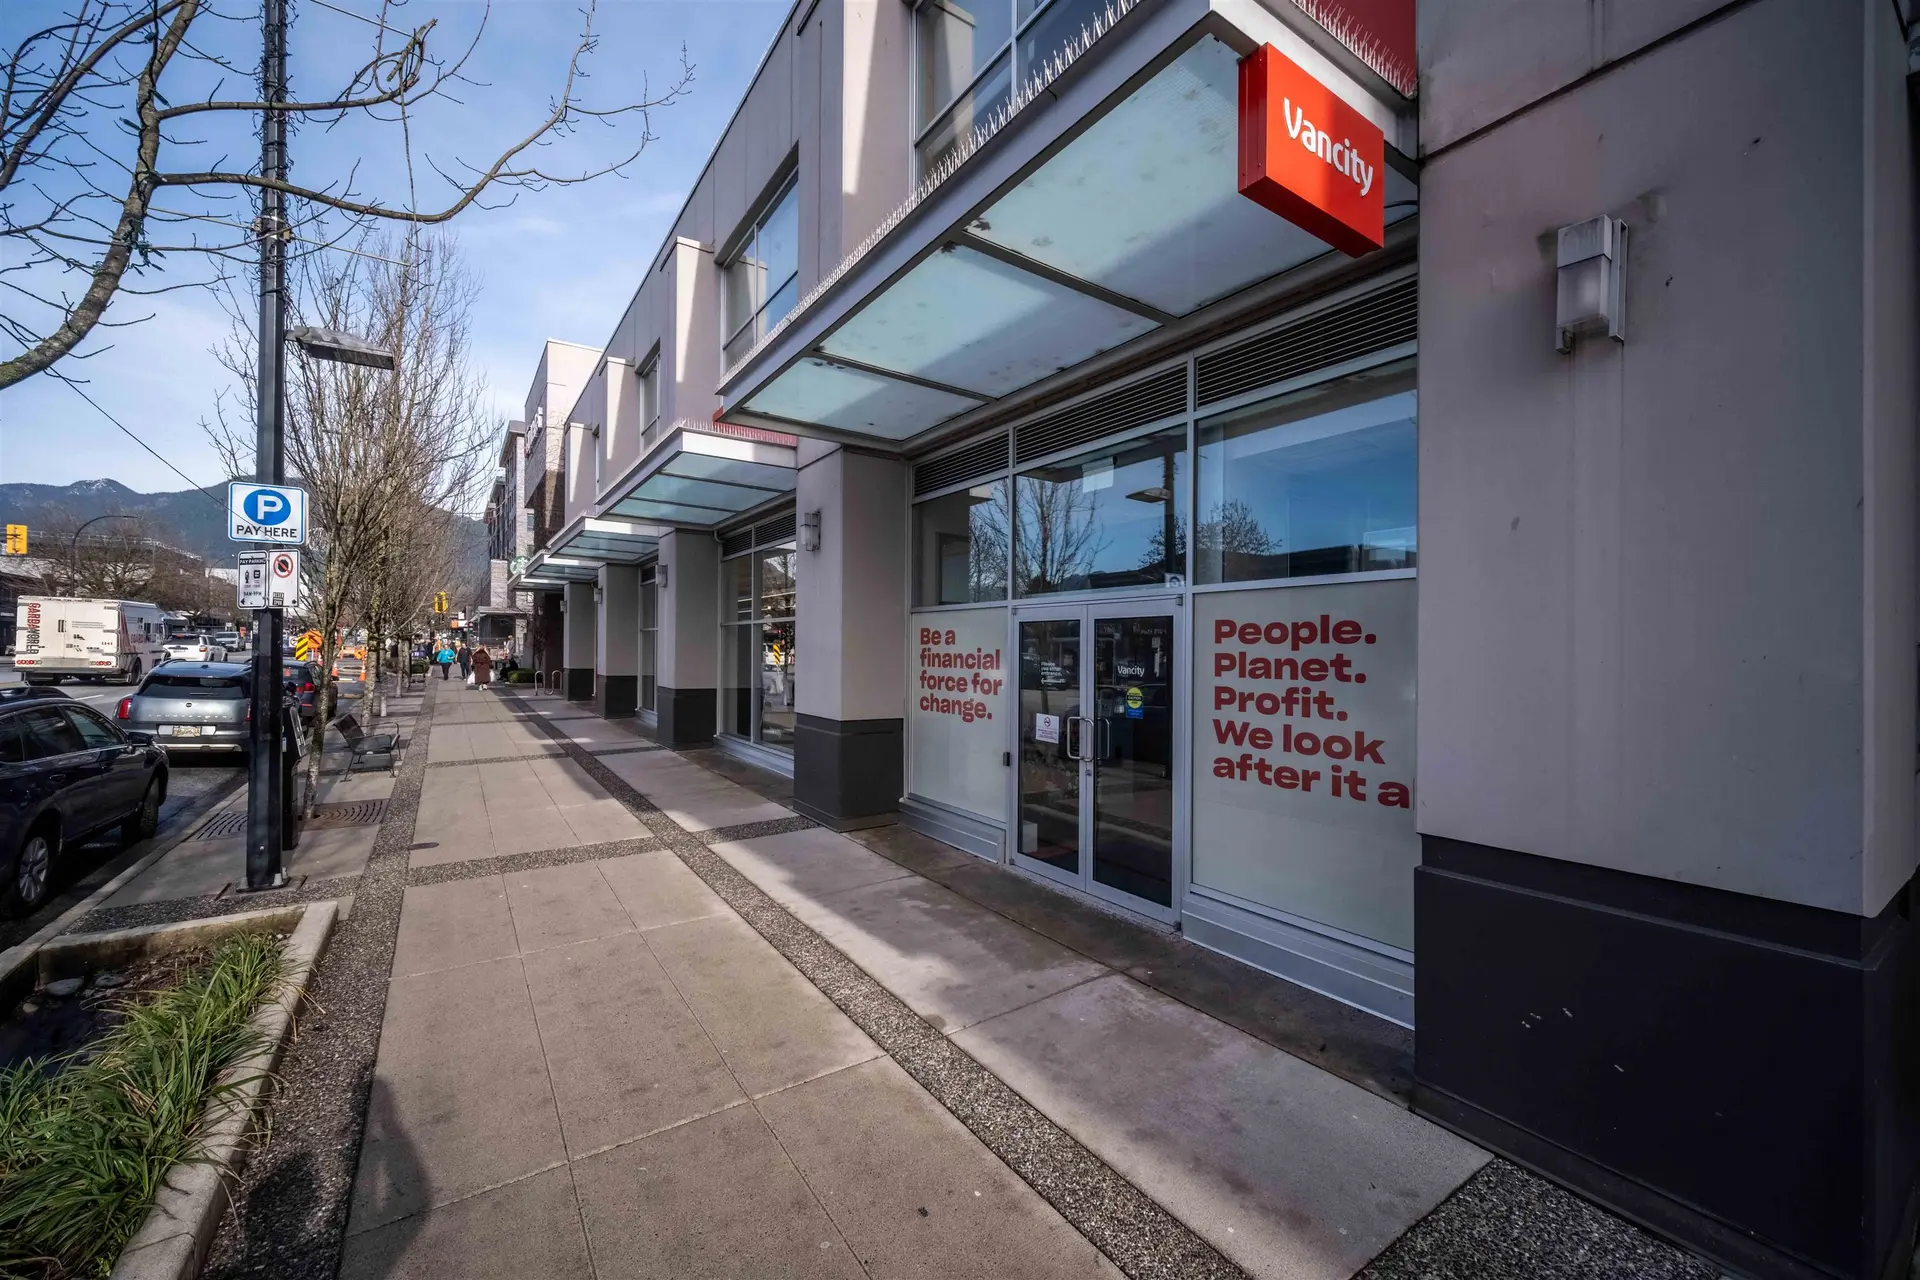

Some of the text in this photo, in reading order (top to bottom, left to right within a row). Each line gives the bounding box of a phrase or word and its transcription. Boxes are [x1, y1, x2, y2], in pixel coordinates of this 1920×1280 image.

[1284, 97, 1374, 197] Vancity
[257, 495, 283, 520] P
[236, 525, 297, 538] PAY HERE
[920, 628, 956, 645] Be a
[1214, 614, 1377, 651] People.
[920, 648, 1001, 670] financial
[1117, 665, 1145, 677] Vancity
[1214, 652, 1367, 684] Planet.
[920, 670, 1002, 696] force for
[920, 694, 993, 723] change.
[1214, 686, 1348, 722] Profit.
[1212, 718, 1386, 765] We look
[1212, 754, 1414, 810] after it a
